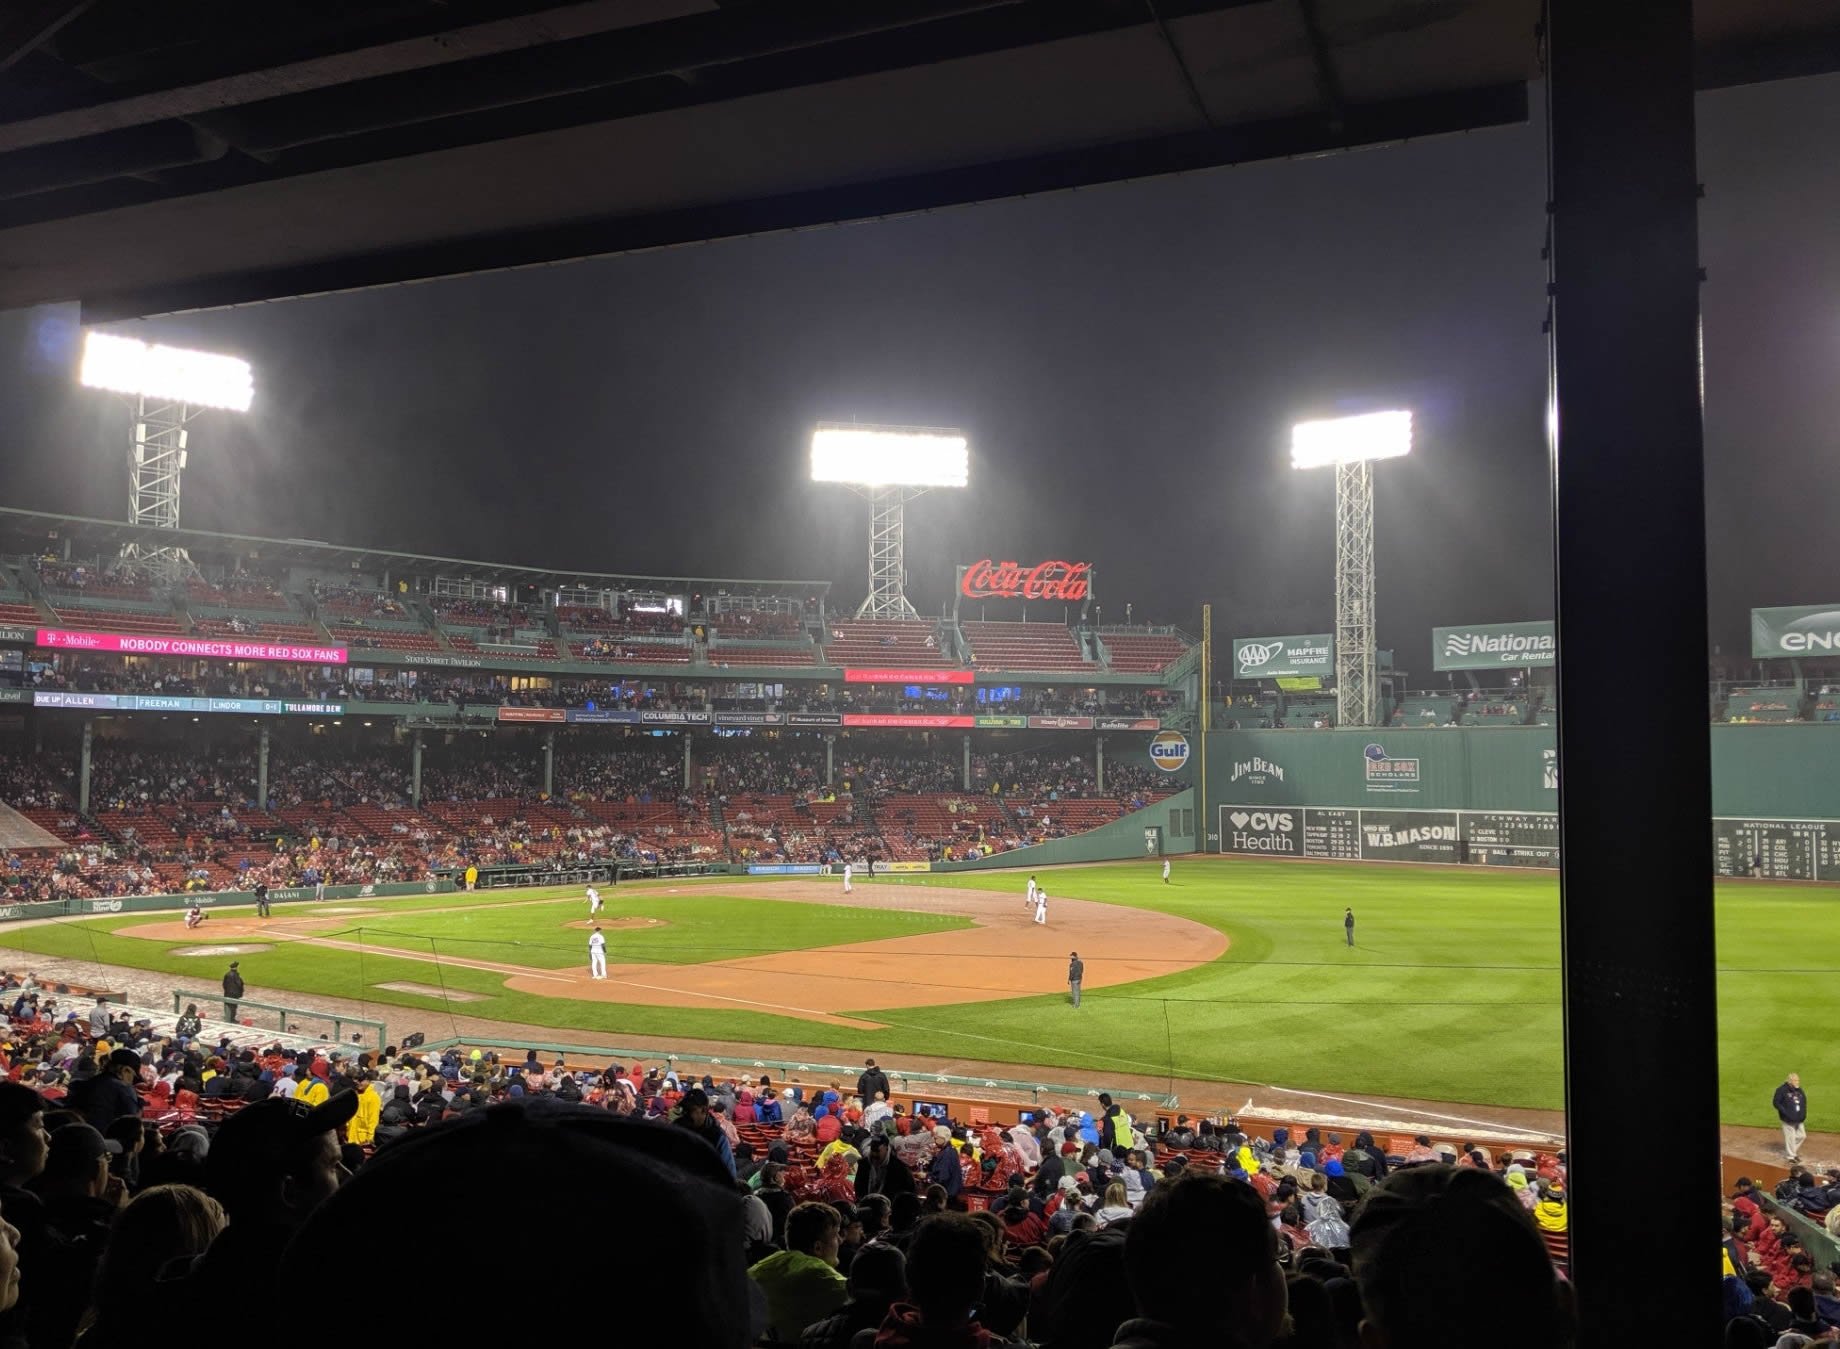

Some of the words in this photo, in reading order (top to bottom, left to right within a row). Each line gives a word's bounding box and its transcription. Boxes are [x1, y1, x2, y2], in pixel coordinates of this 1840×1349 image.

[962, 559, 1093, 600] Coca-Cola
[120, 639, 168, 651] NOBODY
[172, 642, 232, 654] CONNECTS
[235, 646, 265, 656] MORE
[268, 648, 290, 658] RED
[292, 649, 312, 659] SOX
[314, 650, 340, 661] FANS
[1243, 645, 1265, 664] AAA
[1287, 647, 1328, 656] MAPFRE
[405, 655, 426, 664] STATE
[426, 656, 448, 665] STREET
[451, 658, 480, 667] PAVILION
[140, 699, 180, 708] FREEMAN
[644, 712, 686, 720] COLUMBIA
[687, 713, 708, 721] TECH
[1151, 744, 1186, 758] Gulf
[1231, 761, 1251, 782] JIM
[1253, 757, 1284, 782] BEAM
[1250, 812, 1294, 831] CVS
[1233, 832, 1294, 851] Health
